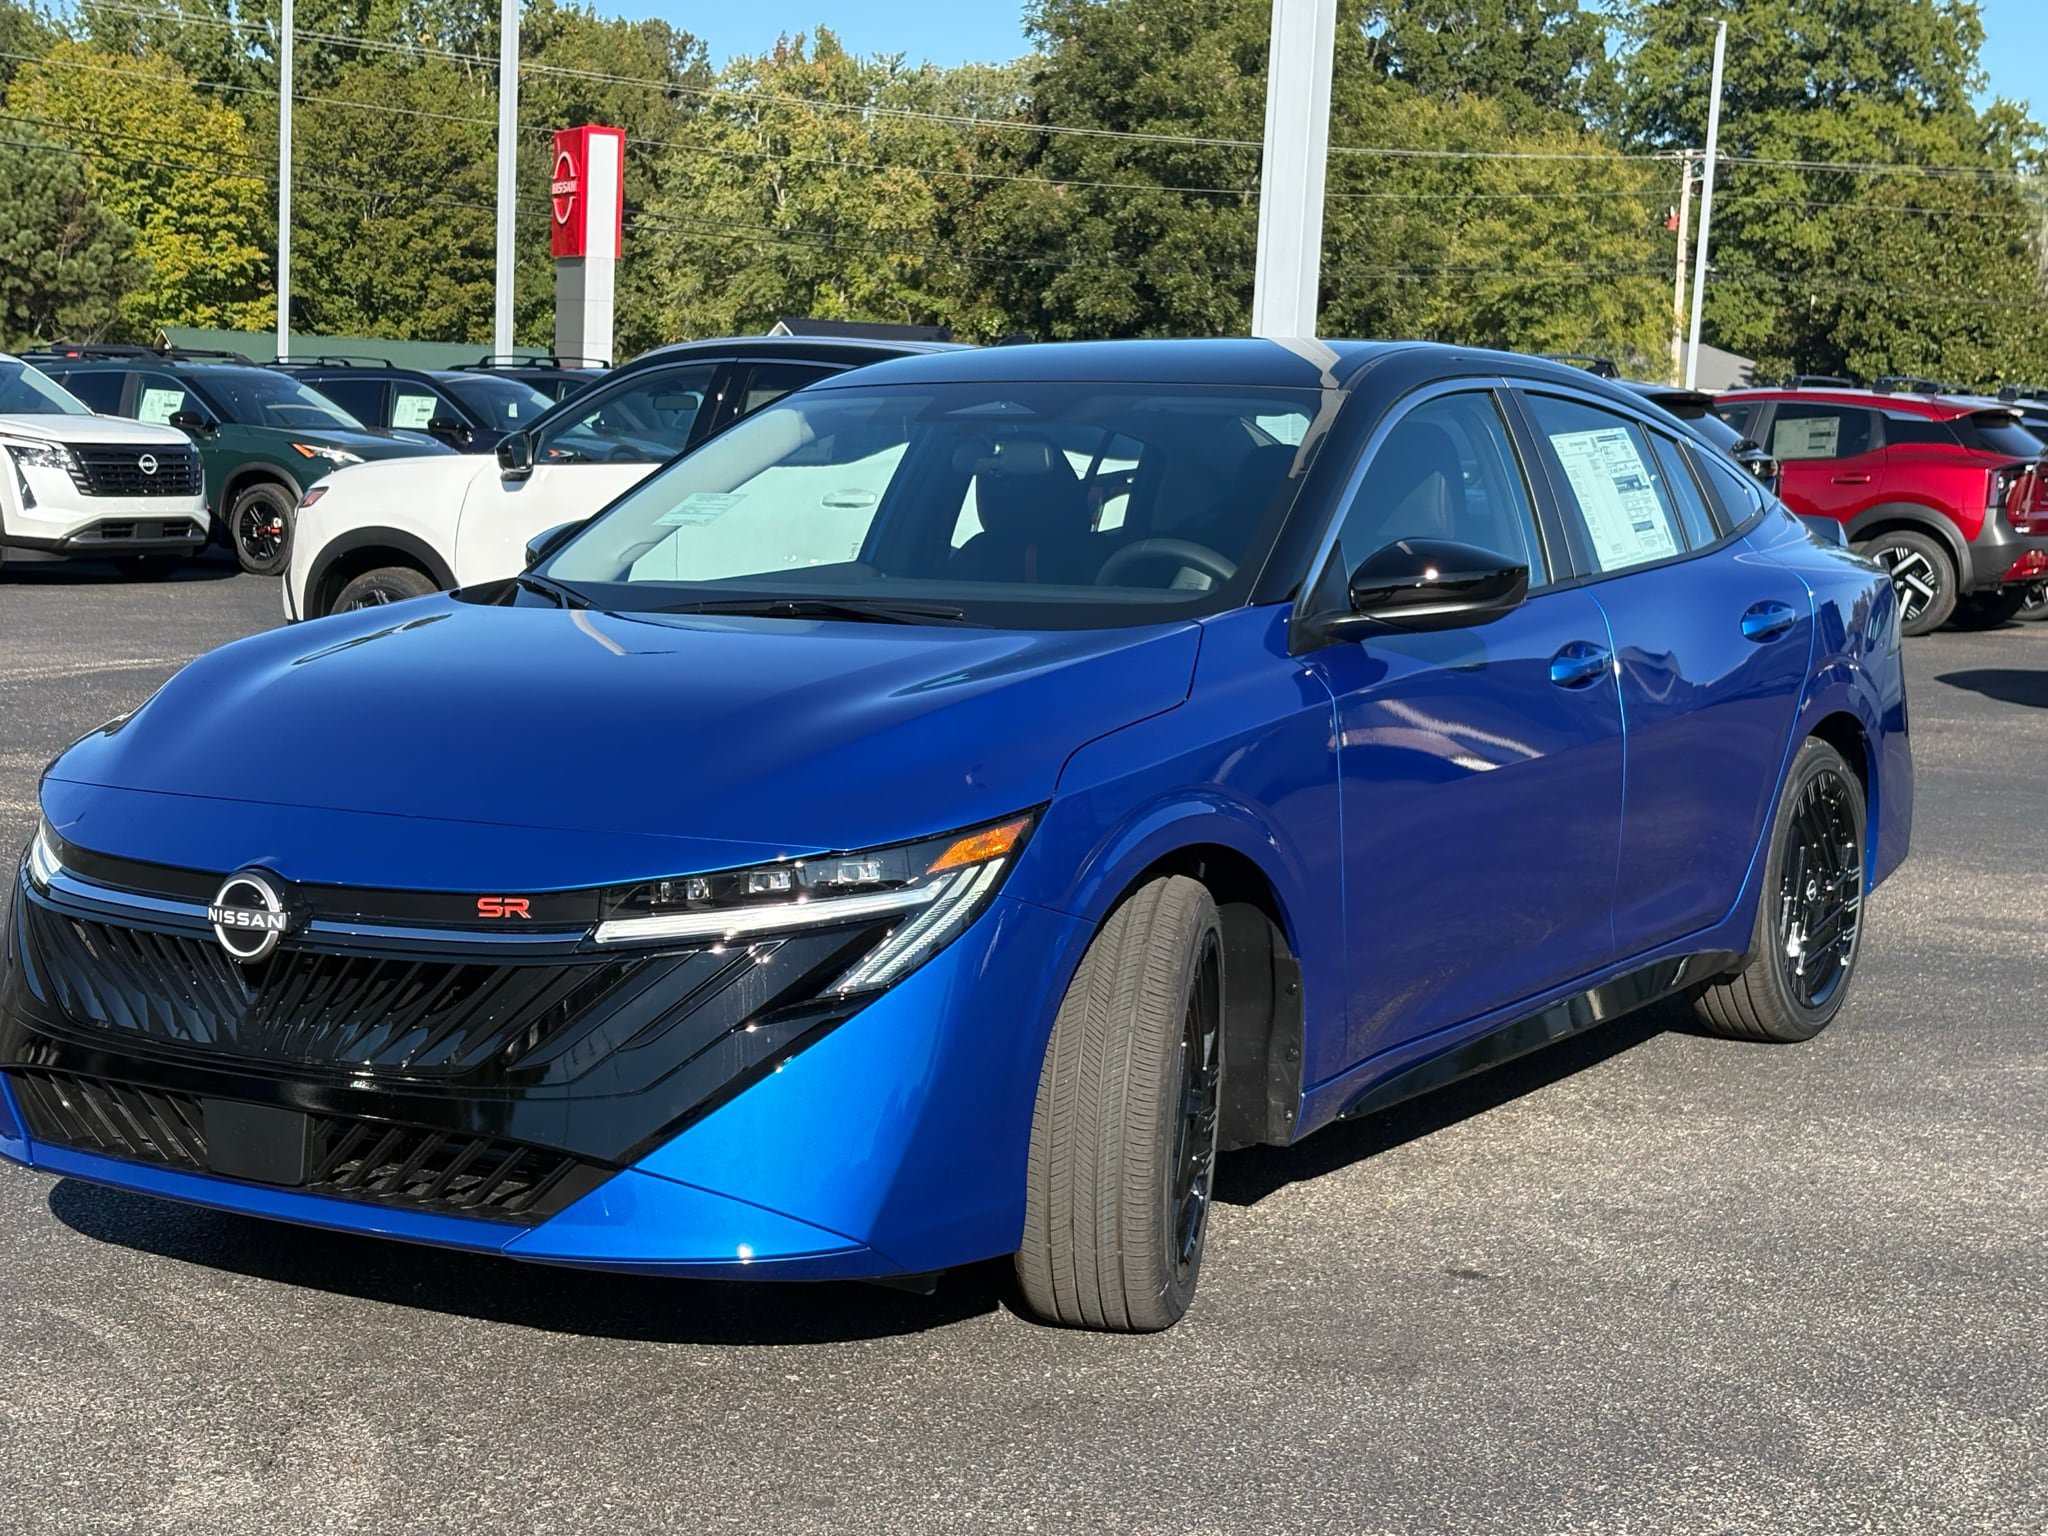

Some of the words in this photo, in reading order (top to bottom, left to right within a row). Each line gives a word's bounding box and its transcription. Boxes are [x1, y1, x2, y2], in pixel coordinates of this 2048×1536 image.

[552, 180, 577, 195] NISSAN
[208, 907, 283, 929] NISSAN
[477, 897, 531, 919] SR
